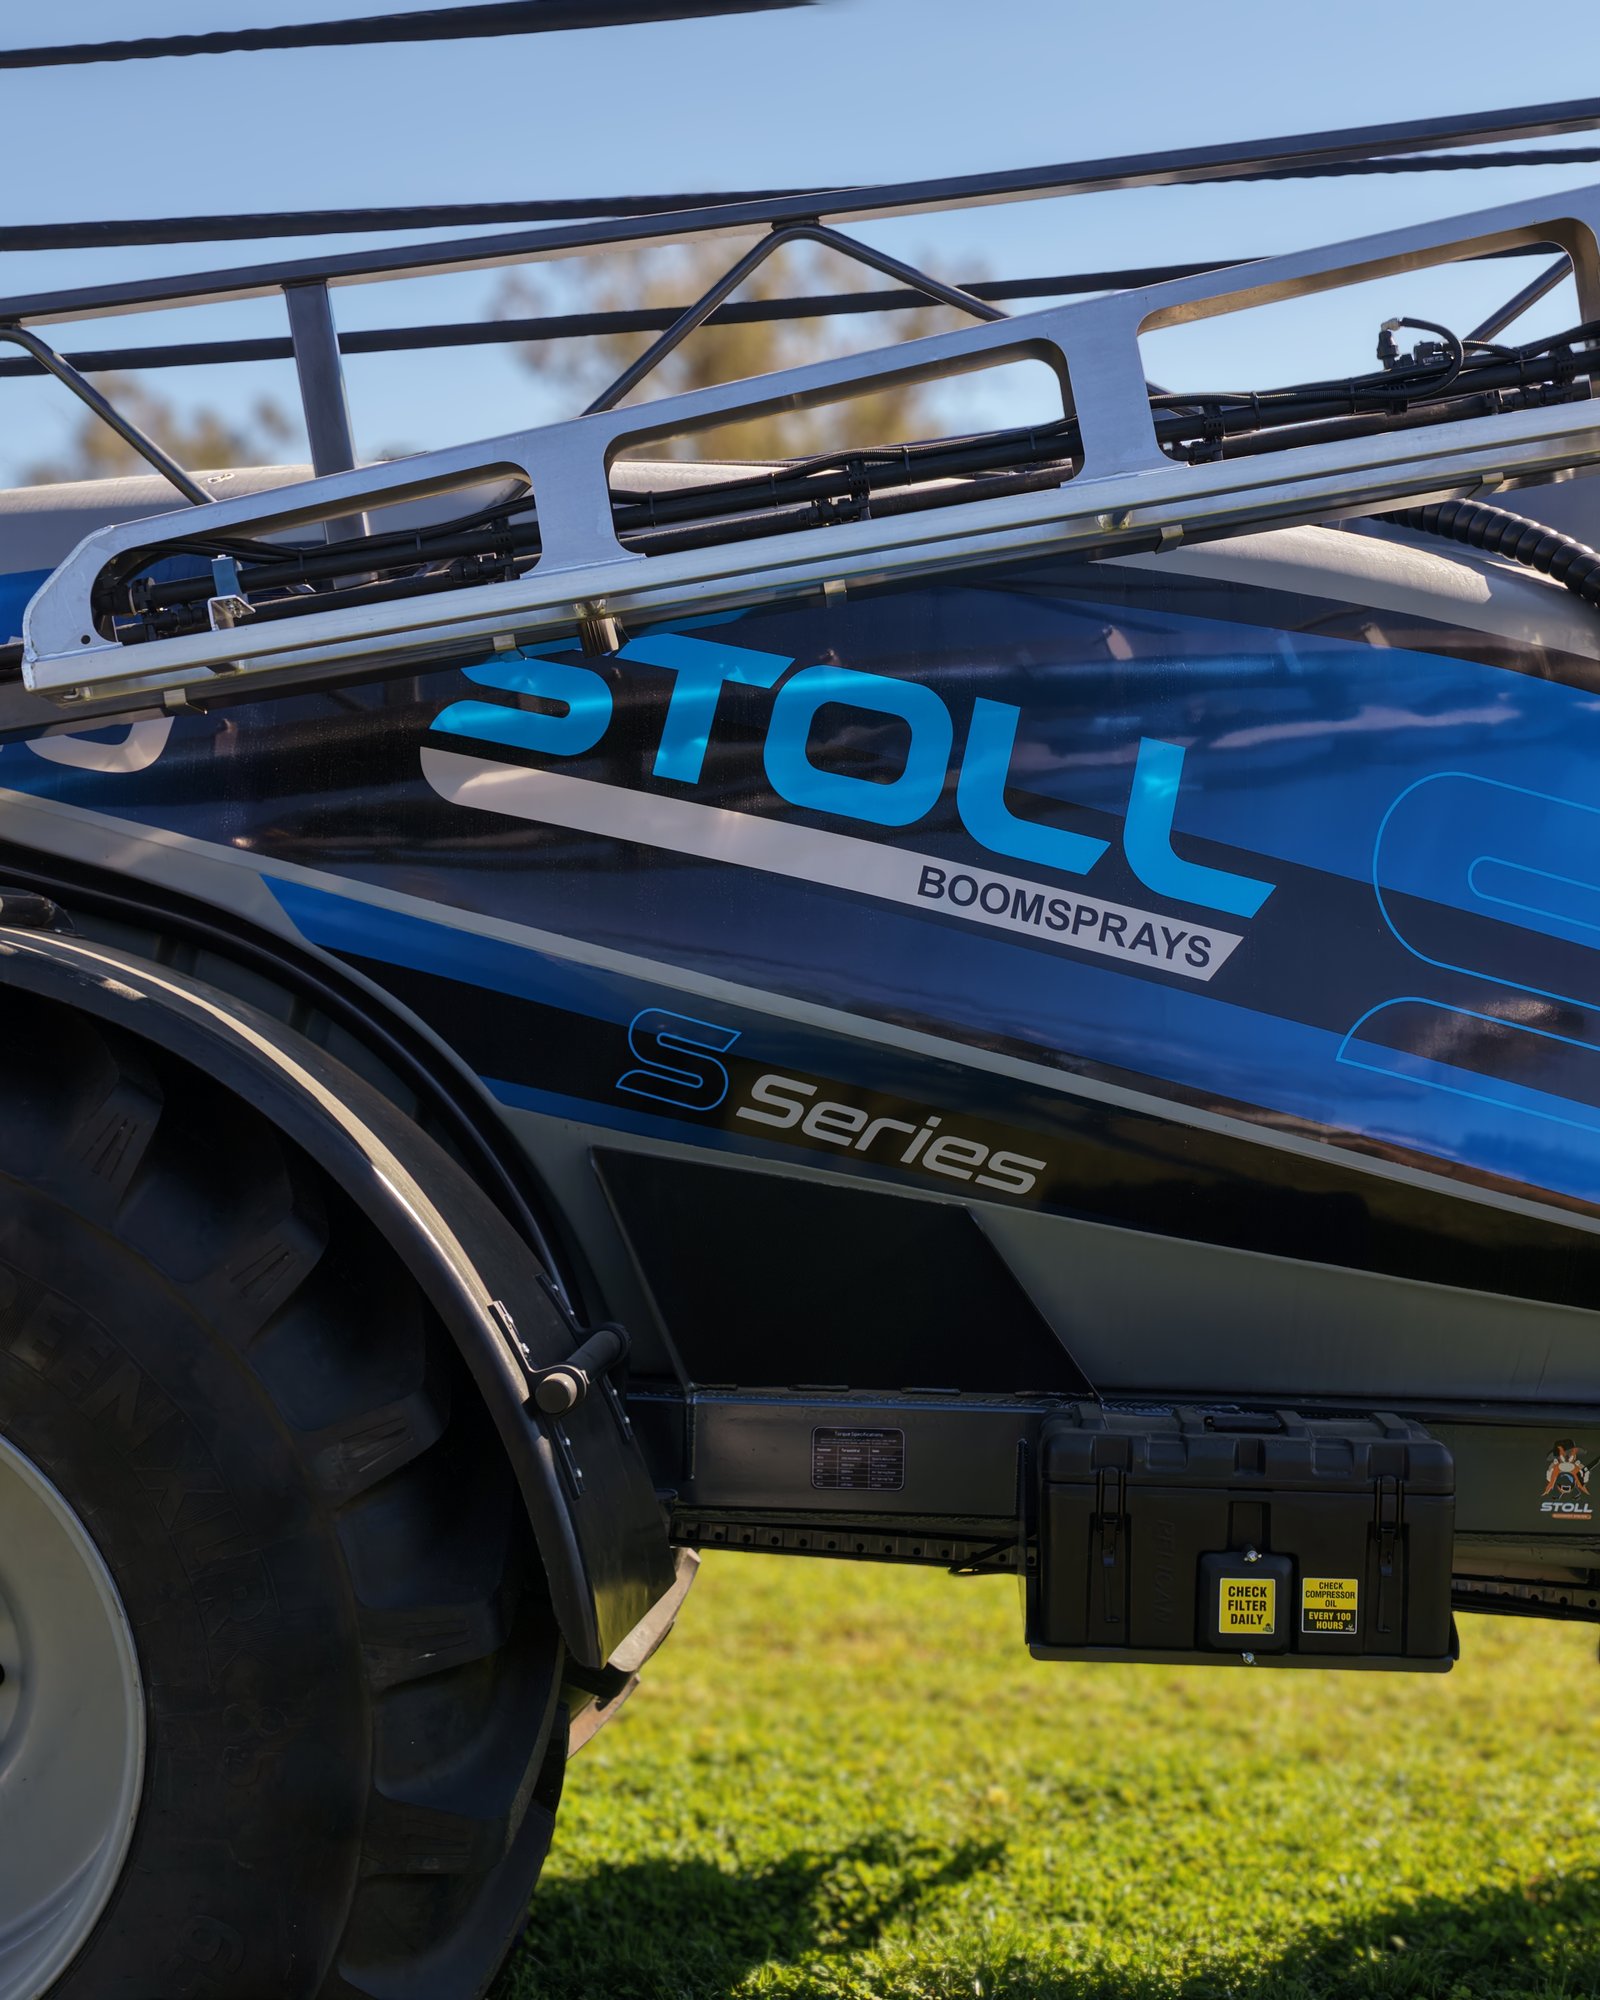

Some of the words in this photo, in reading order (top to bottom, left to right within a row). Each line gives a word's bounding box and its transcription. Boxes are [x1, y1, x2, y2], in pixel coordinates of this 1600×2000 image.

[429, 632, 1277, 918] STOLL
[916, 865, 1212, 969] BOOMSPRAYS
[615, 1007, 742, 1112] S
[735, 1073, 1047, 1195] Series
[1540, 1501, 1593, 1513] STOLL
[1228, 1585, 1267, 1598] CHECK
[1318, 1581, 1344, 1590] CHECK
[1305, 1590, 1356, 1599] COMPRESSOR
[1227, 1599, 1267, 1612] FILTER
[1325, 1599, 1337, 1608] OIL
[1230, 1613, 1264, 1625] DAILY
[1308, 1611, 1334, 1621] EVERY
[1336, 1612, 1351, 1621] 100
[1316, 1620, 1344, 1630] HOURS
